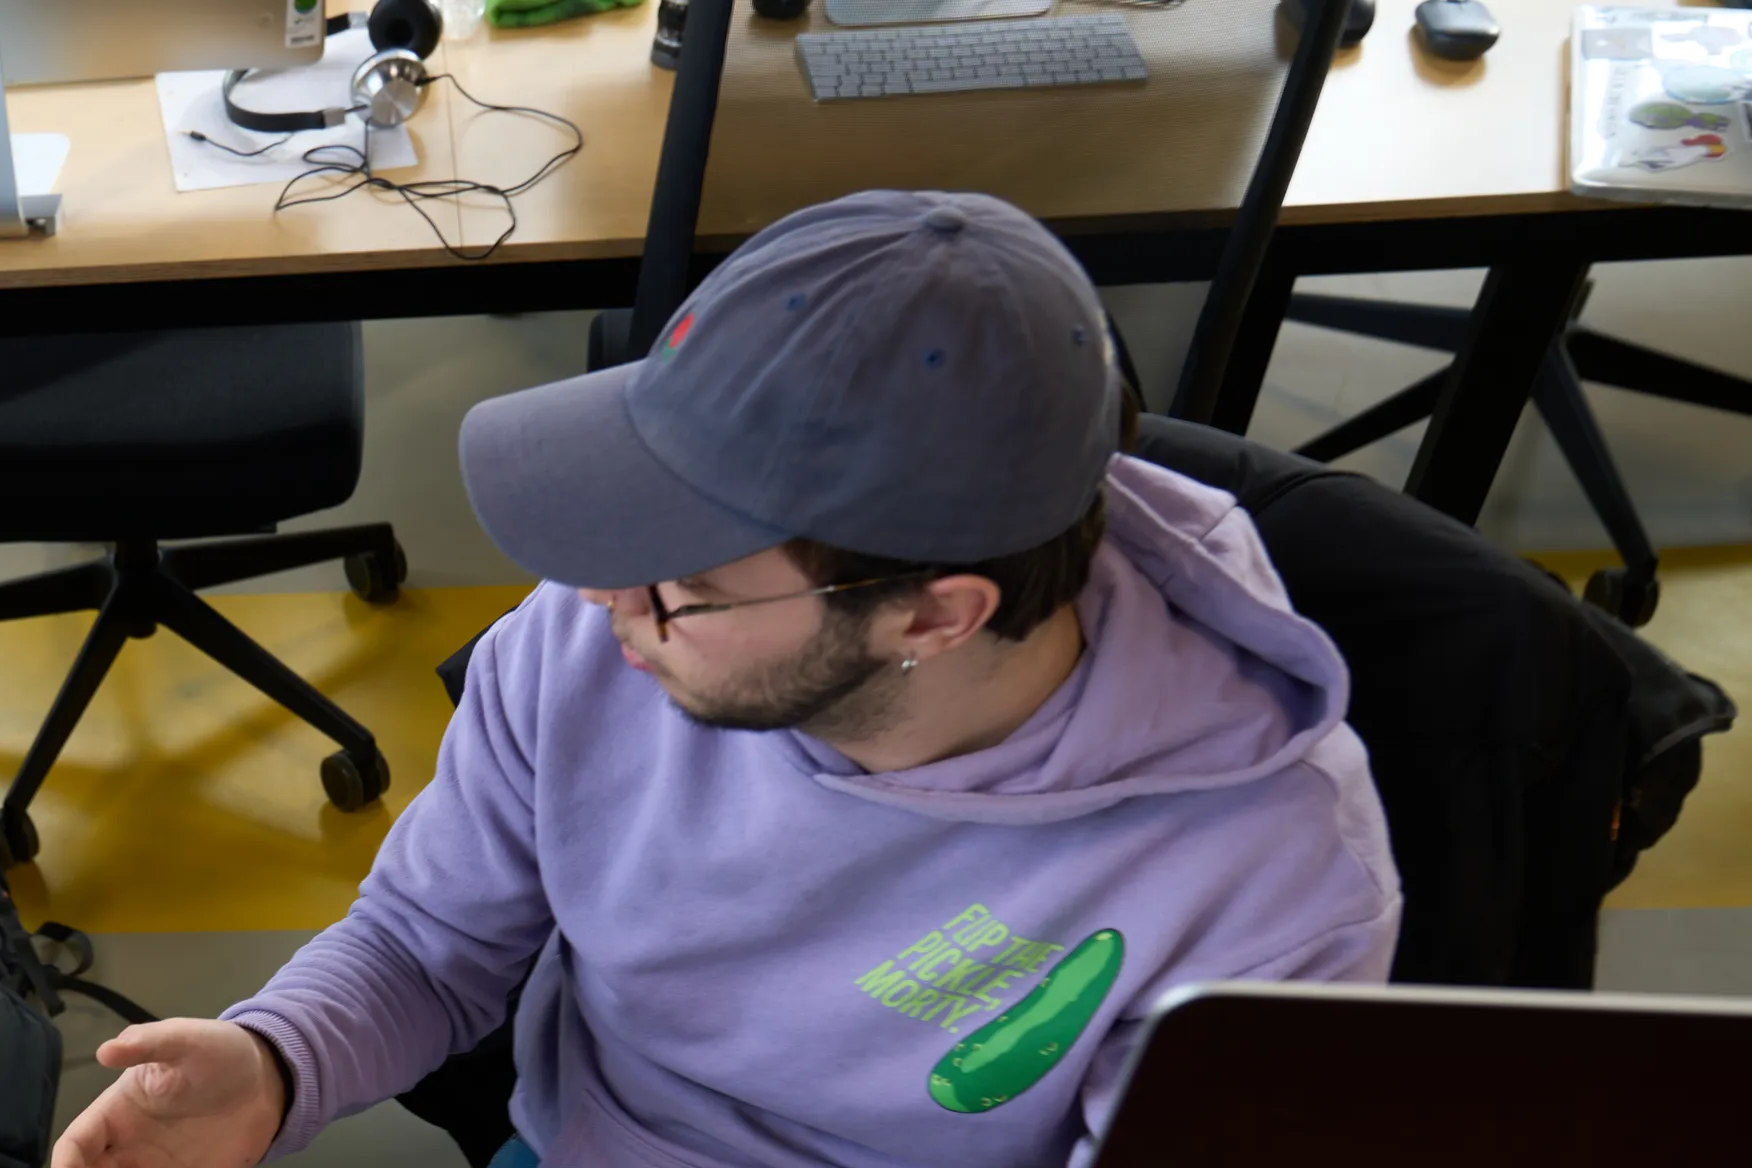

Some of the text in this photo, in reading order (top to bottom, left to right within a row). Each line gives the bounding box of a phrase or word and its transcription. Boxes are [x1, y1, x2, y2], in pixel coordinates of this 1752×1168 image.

[896, 930, 1024, 1012] PICKLE,
[943, 903, 1064, 976] FLIP THE
[854, 959, 982, 1034] MORTY.
